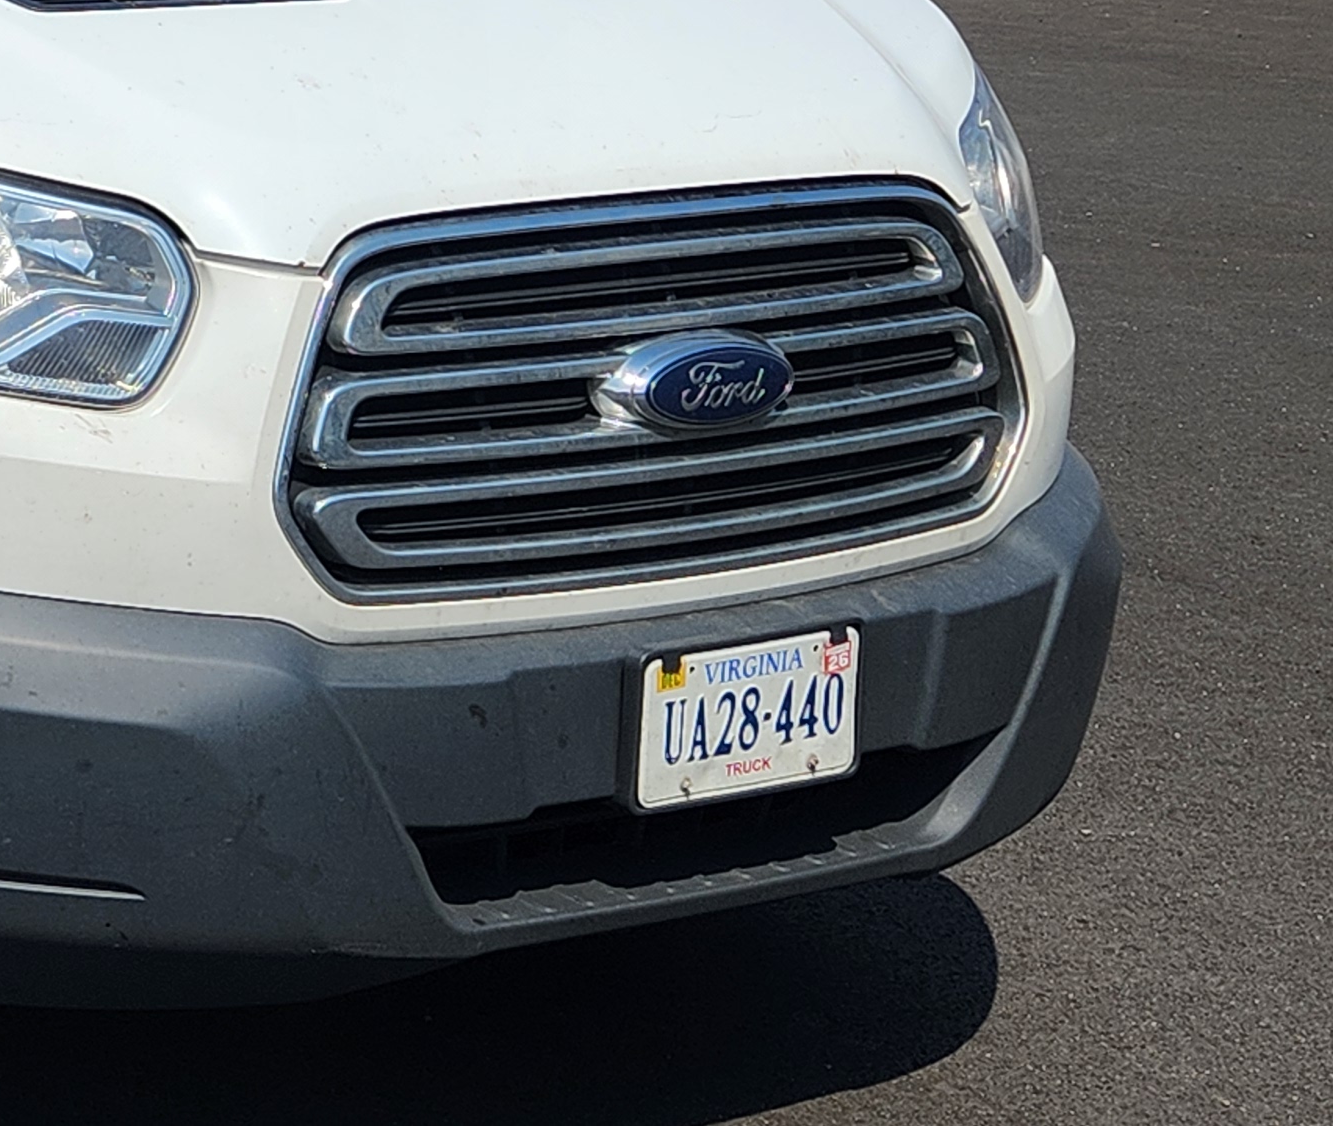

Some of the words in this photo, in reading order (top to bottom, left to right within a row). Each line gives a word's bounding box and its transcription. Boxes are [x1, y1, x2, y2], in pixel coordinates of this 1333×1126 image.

[681, 360, 766, 412] Ford
[704, 647, 804, 685] VIRGINIA
[827, 652, 849, 672] 26
[664, 672, 844, 766] UA28-440
[725, 756, 772, 778] TRUCK
